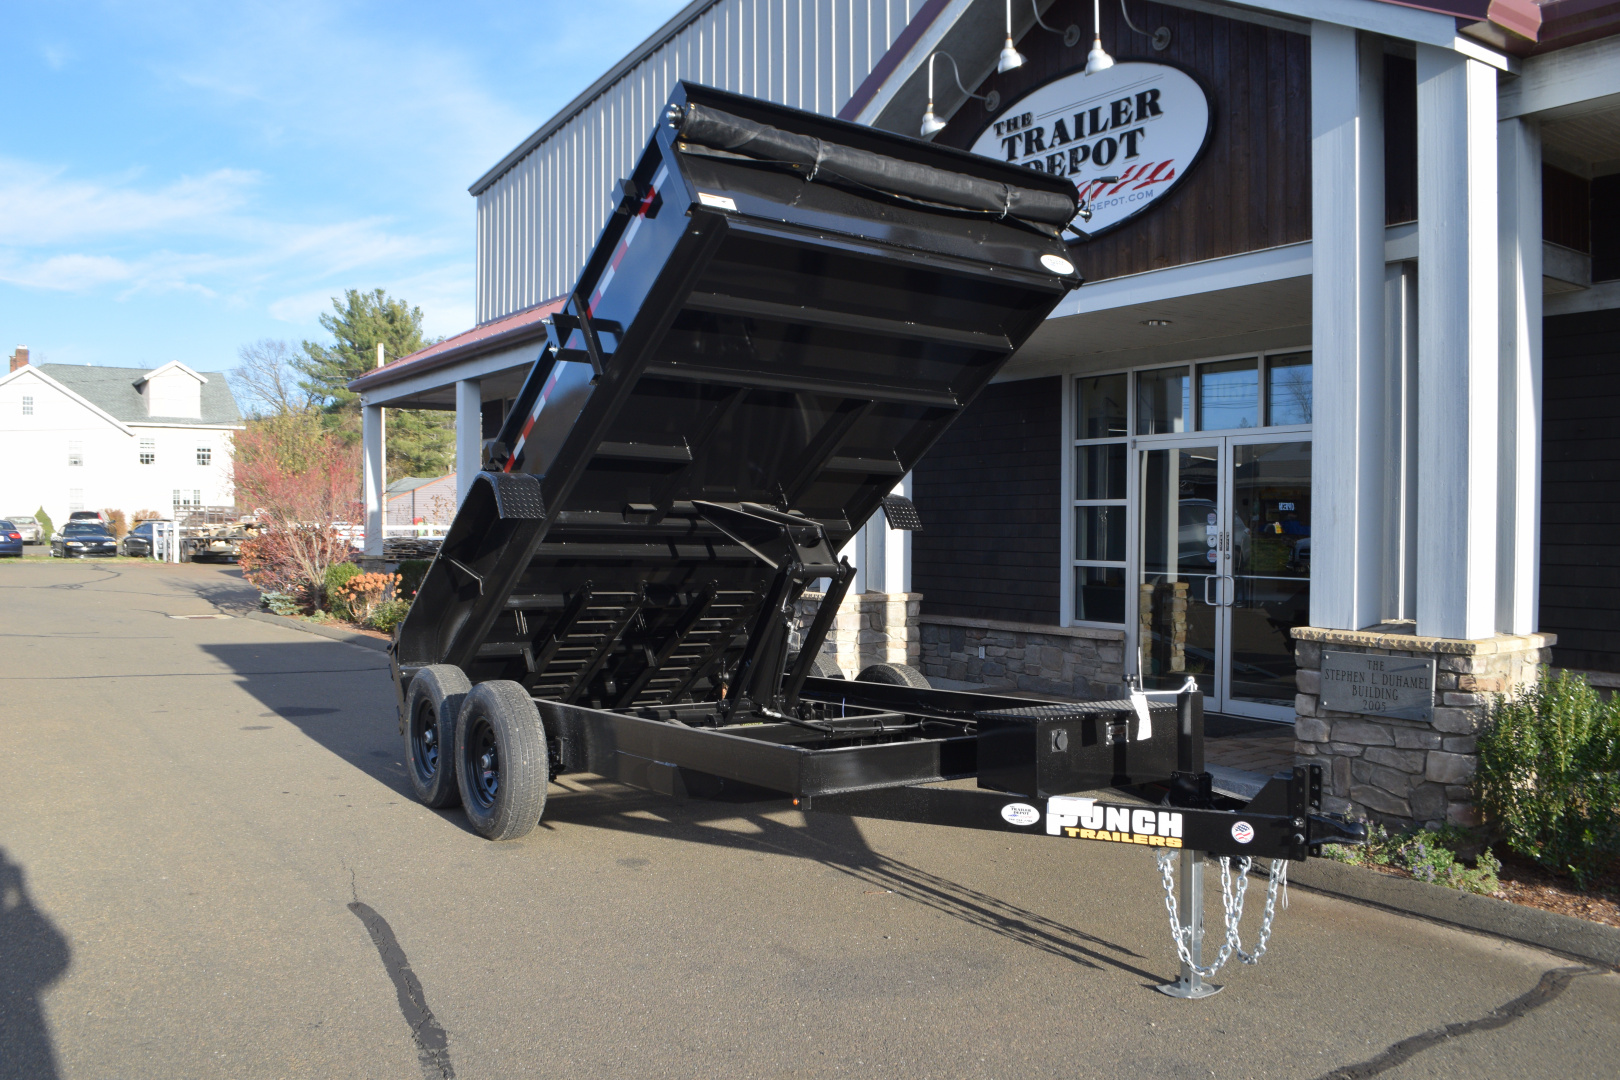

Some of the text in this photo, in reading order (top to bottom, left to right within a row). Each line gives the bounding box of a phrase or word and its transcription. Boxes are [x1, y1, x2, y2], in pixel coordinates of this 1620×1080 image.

[994, 111, 1033, 136] THE
[1001, 88, 1164, 162] TRAILER
[1366, 659, 1385, 672] THE
[1324, 668, 1365, 683] STEPHEN
[1382, 673, 1430, 690] DUHAMEL
[1351, 684, 1399, 701] BUILDING
[1362, 699, 1387, 713] 2005
[1064, 827, 1183, 848] TRAILERS
